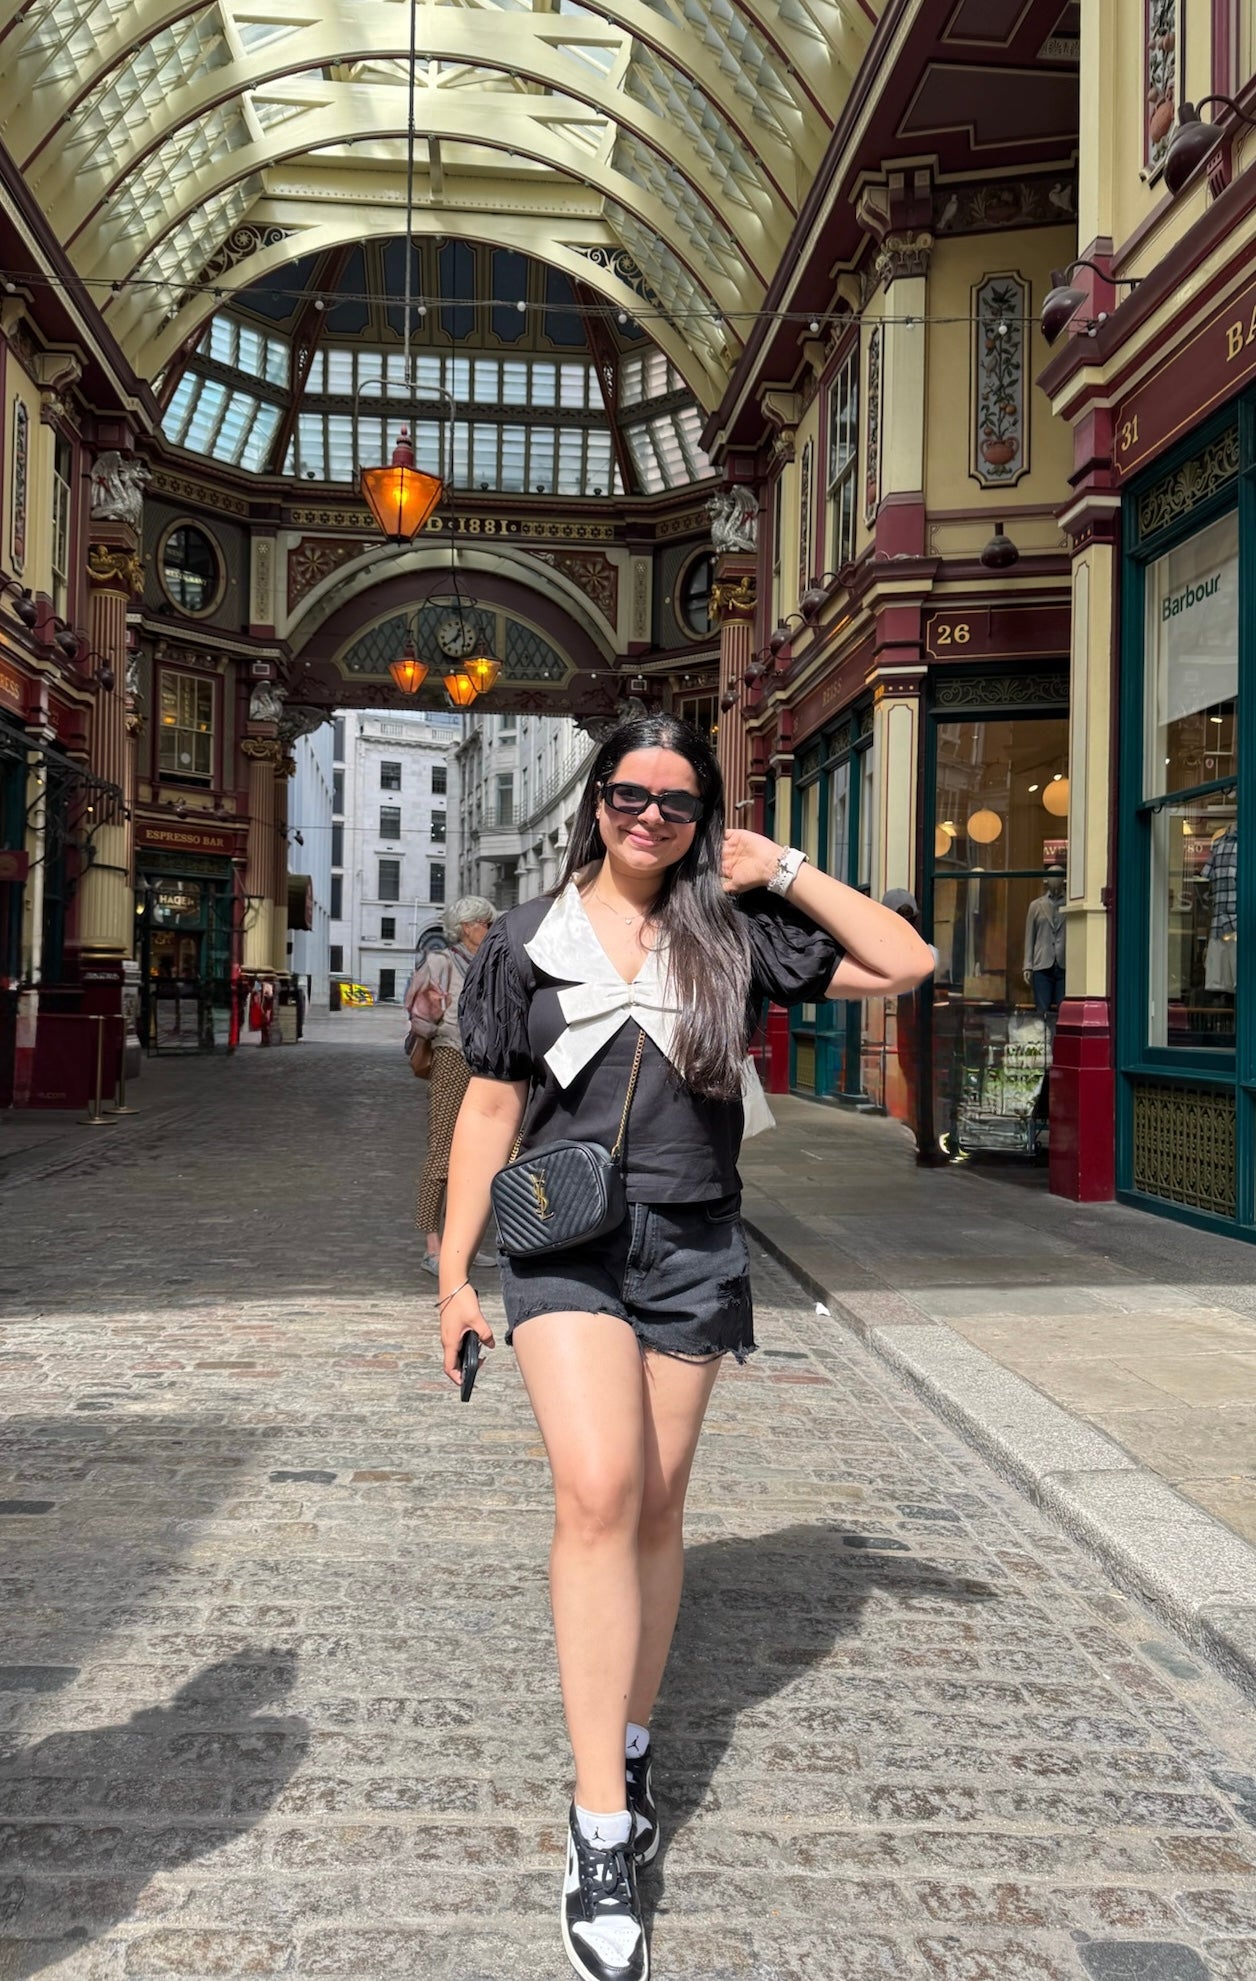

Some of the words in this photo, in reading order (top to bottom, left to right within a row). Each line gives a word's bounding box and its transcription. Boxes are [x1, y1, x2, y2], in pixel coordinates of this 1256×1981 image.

[1121, 415, 1139, 451] 31
[458, 518, 509, 535] 1881
[1162, 573, 1221, 622] Barbour
[937, 624, 970, 644] 26
[146, 829, 201, 844] ESPRESSO
[202, 836, 224, 848] BAR
